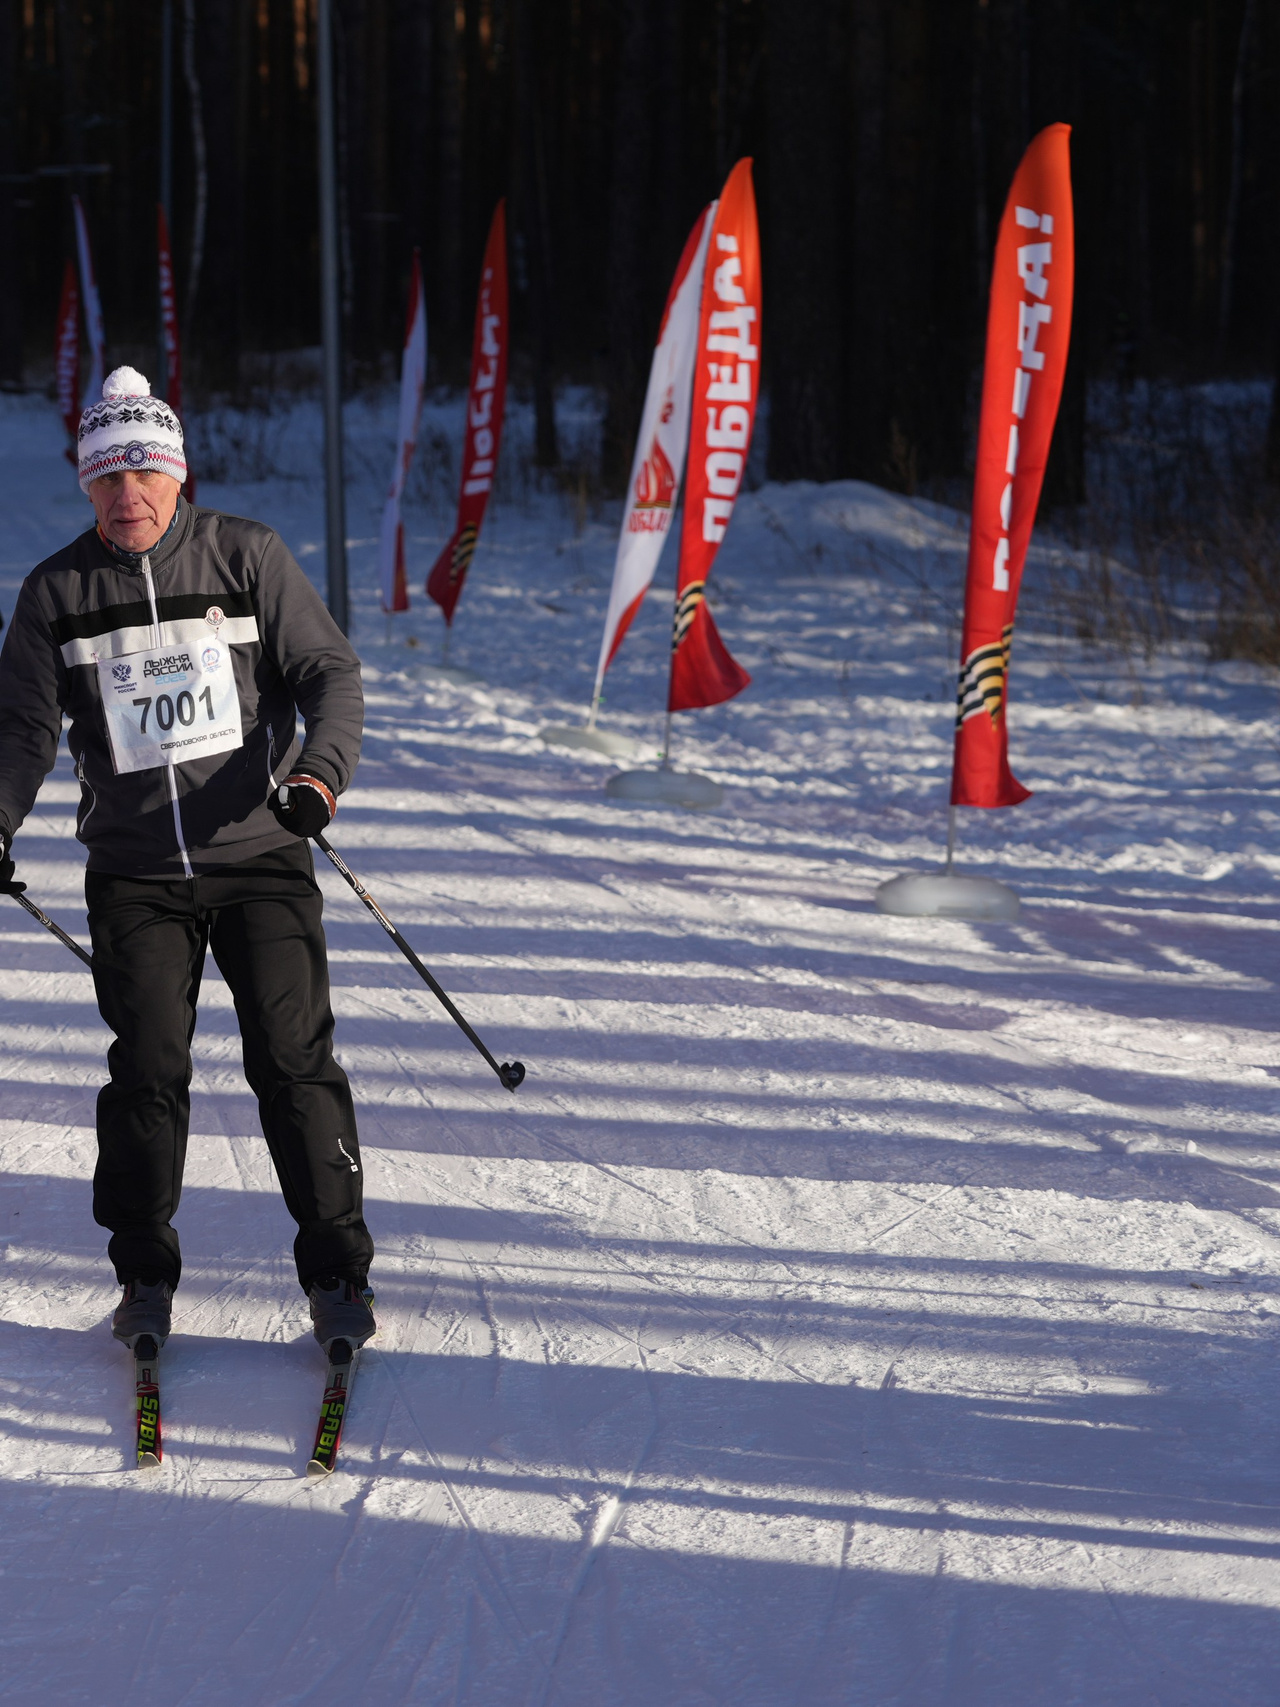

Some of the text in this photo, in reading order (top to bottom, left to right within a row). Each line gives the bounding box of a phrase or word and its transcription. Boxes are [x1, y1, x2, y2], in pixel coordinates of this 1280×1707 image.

[143, 662, 193, 678] РОССИИ
[144, 654, 190, 669] ЛЫЖНЯ
[154, 674, 187, 685] 2025
[133, 686, 215, 734] 7001
[160, 728, 236, 750] СВЕРДЛОВСКАЯ ОБЛАСТЬ
[314, 1402, 344, 1467] SABL
